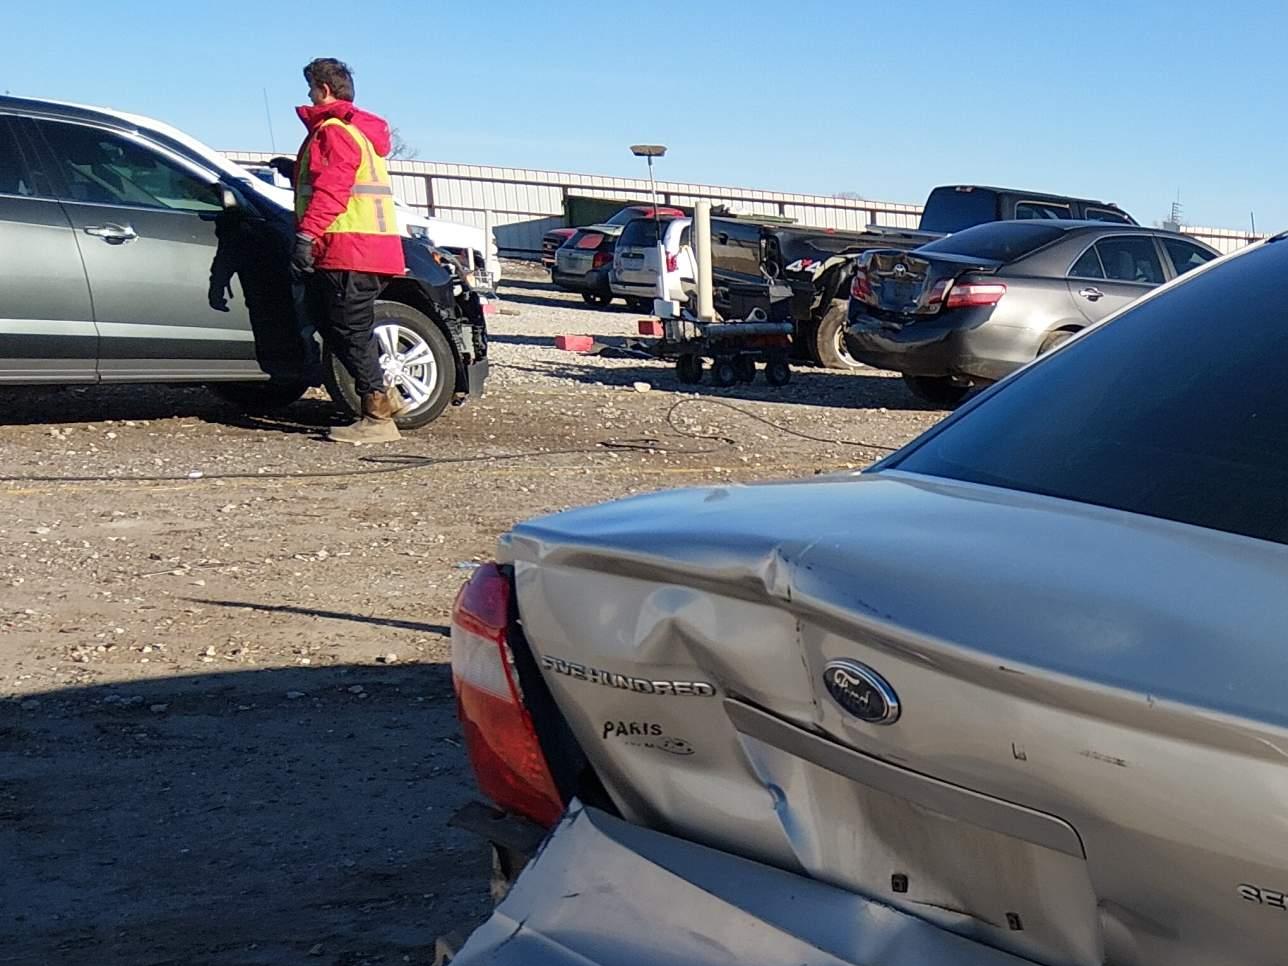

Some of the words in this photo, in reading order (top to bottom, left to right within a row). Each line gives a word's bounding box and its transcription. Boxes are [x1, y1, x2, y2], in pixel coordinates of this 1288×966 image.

[541, 655, 587, 680] FIVE
[589, 668, 717, 696] HUNDRED
[834, 669, 873, 712] Ford
[602, 720, 663, 739] PARIS
